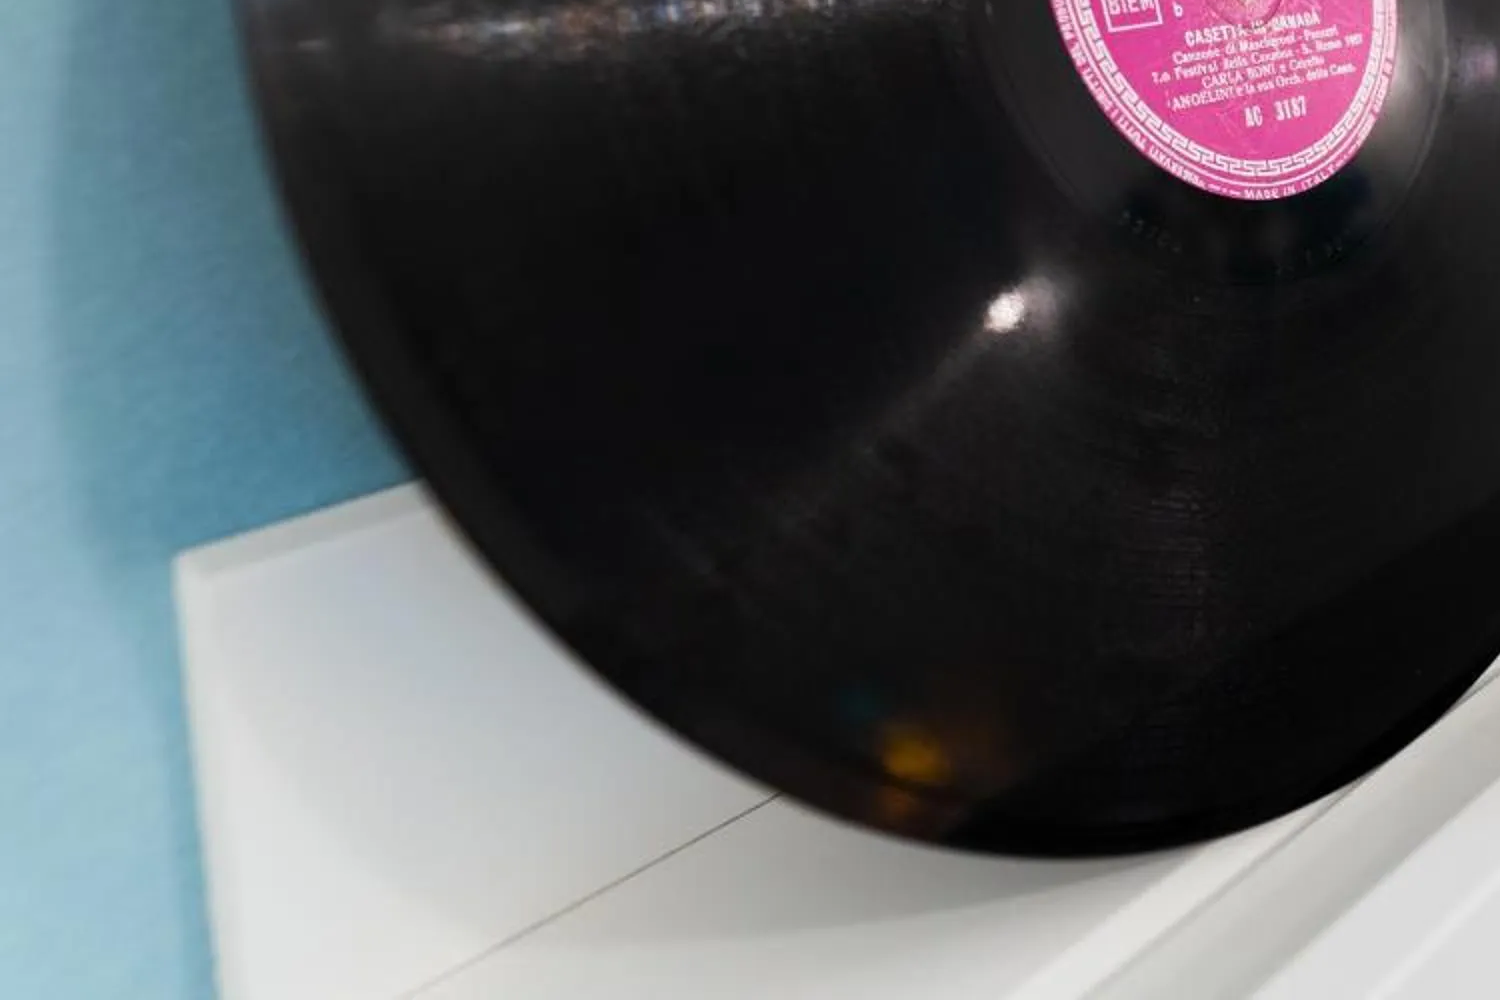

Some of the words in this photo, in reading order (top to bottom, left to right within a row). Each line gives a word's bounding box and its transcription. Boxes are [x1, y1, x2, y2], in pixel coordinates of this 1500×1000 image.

[1201, 70, 1244, 89] CARLA
[1243, 188, 1279, 200] MADE
[1283, 184, 1297, 196] IN
[1301, 164, 1337, 190] ITALY
